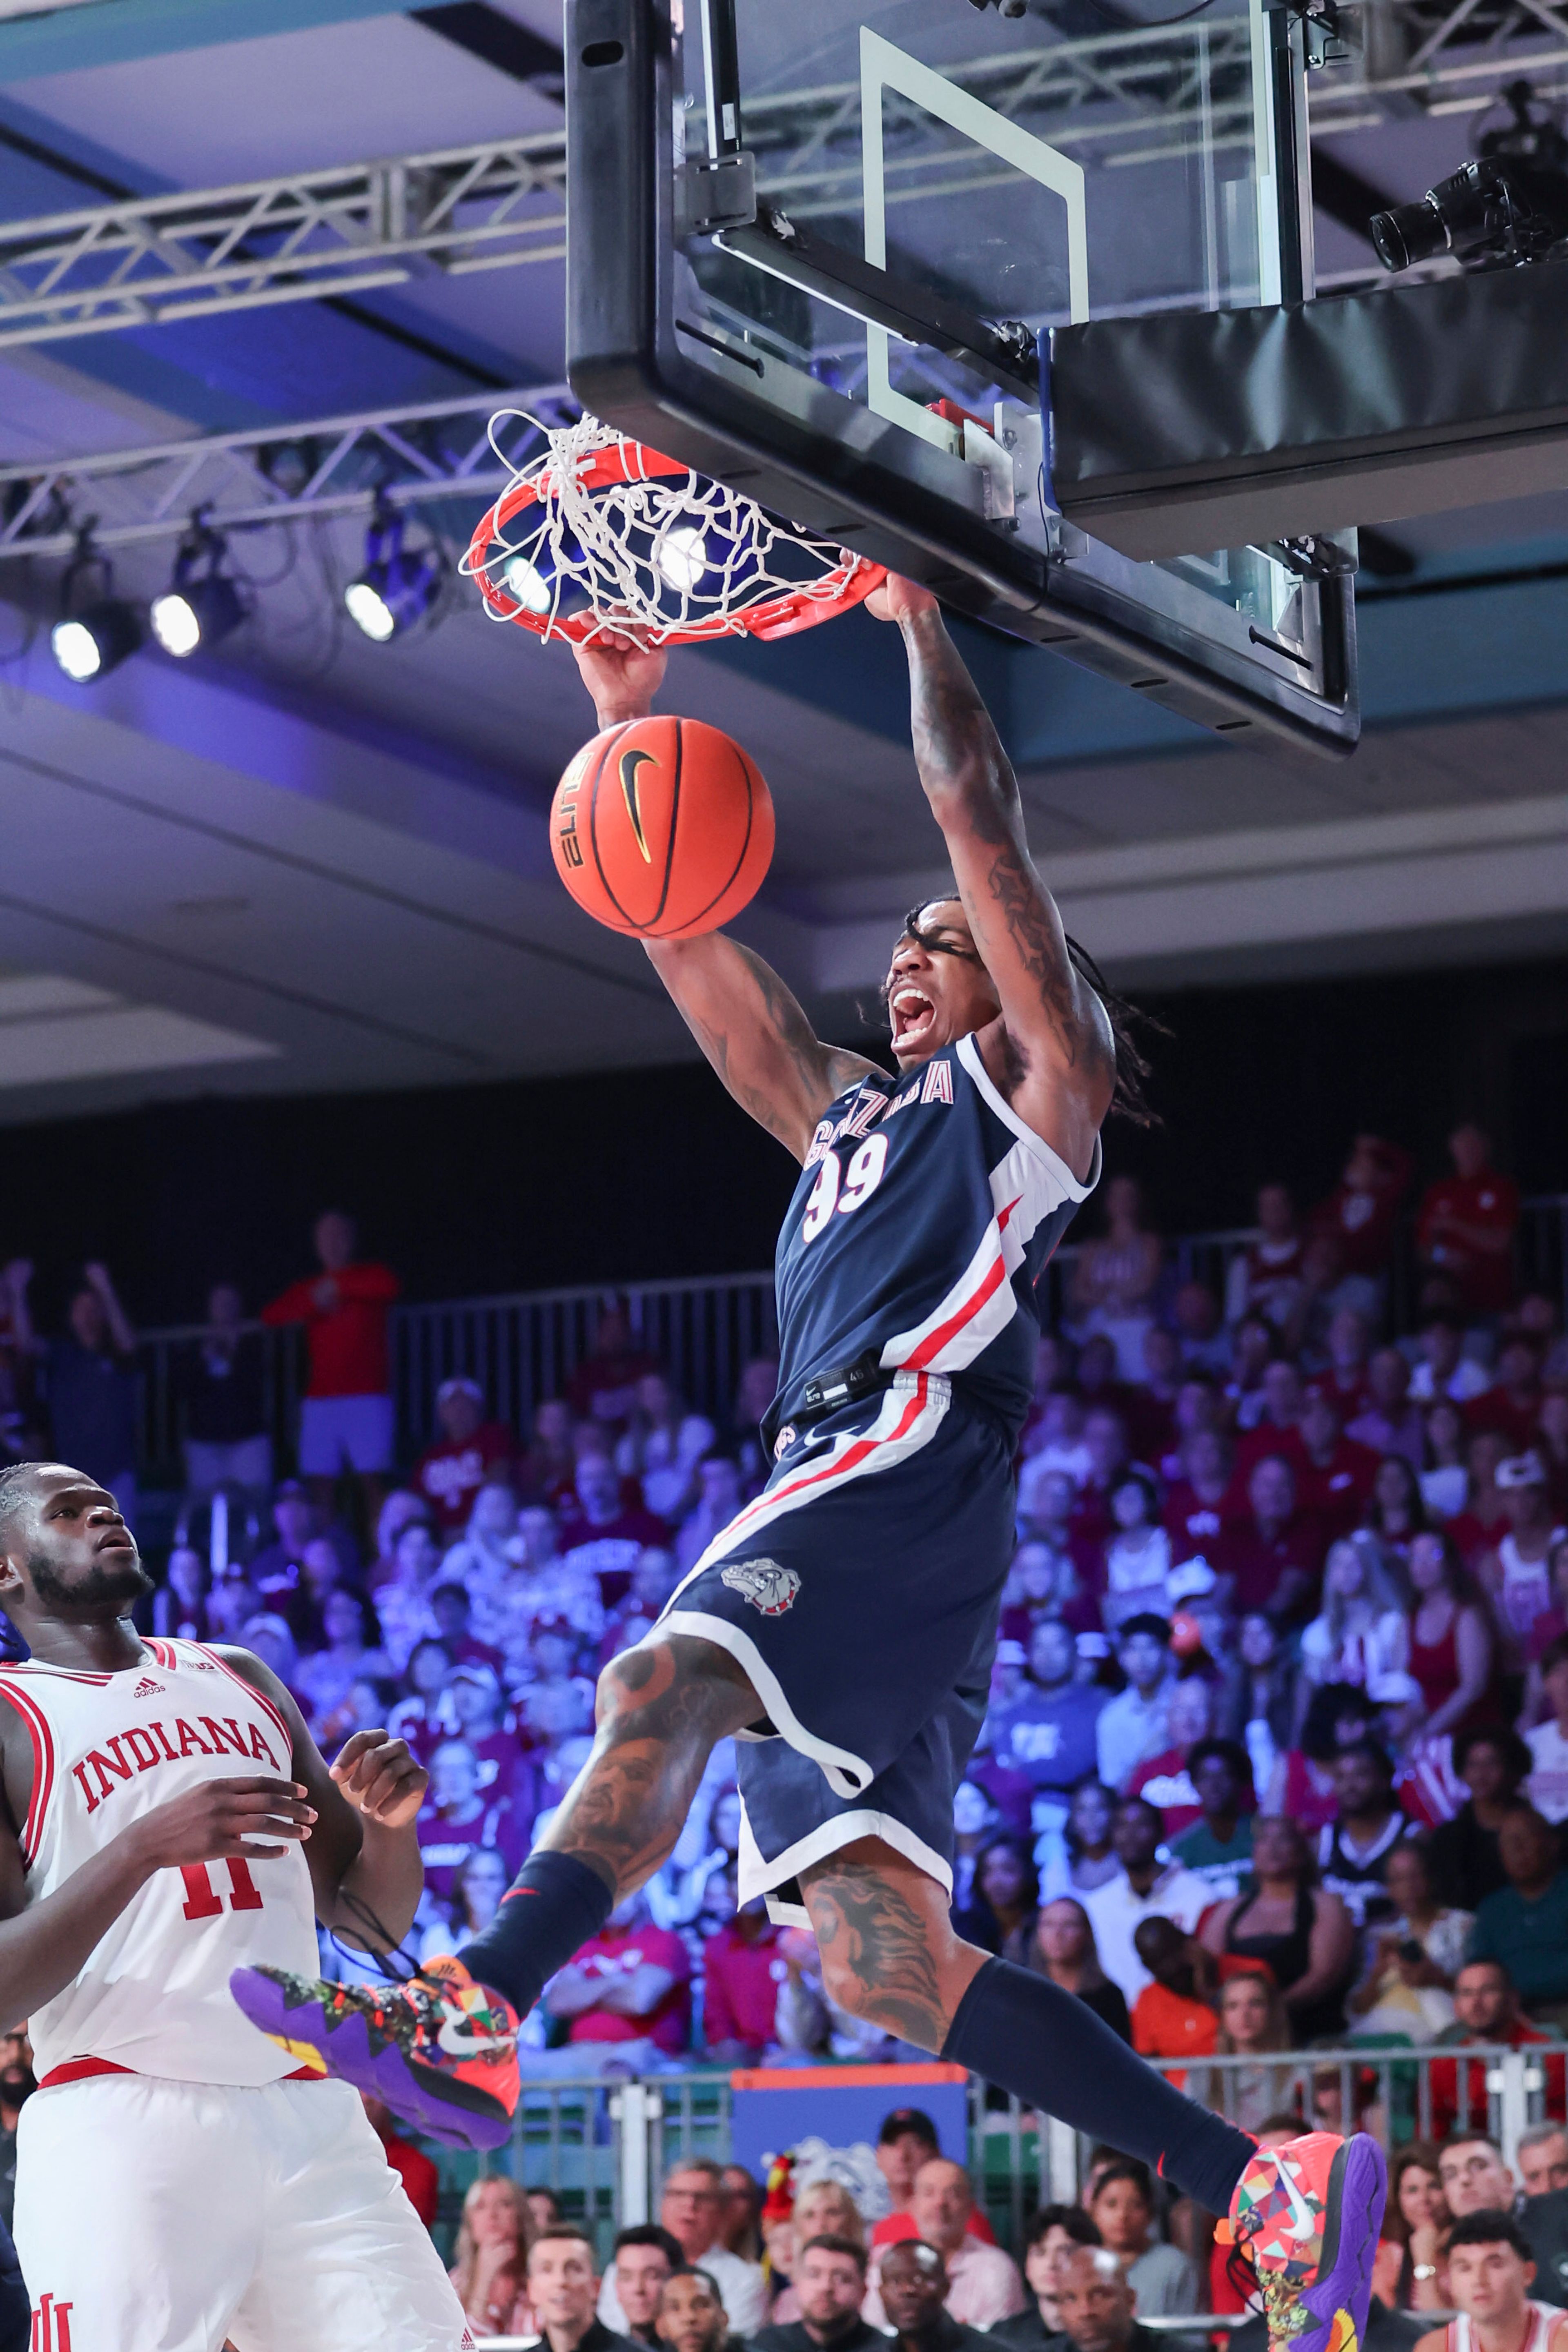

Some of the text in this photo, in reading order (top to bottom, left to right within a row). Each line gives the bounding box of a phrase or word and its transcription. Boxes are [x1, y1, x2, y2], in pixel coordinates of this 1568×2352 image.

[803, 1131, 889, 1244] 99
[134, 1685, 166, 1698] adidas
[72, 1716, 281, 1815] INDIANA
[180, 1857, 264, 1920] 11
